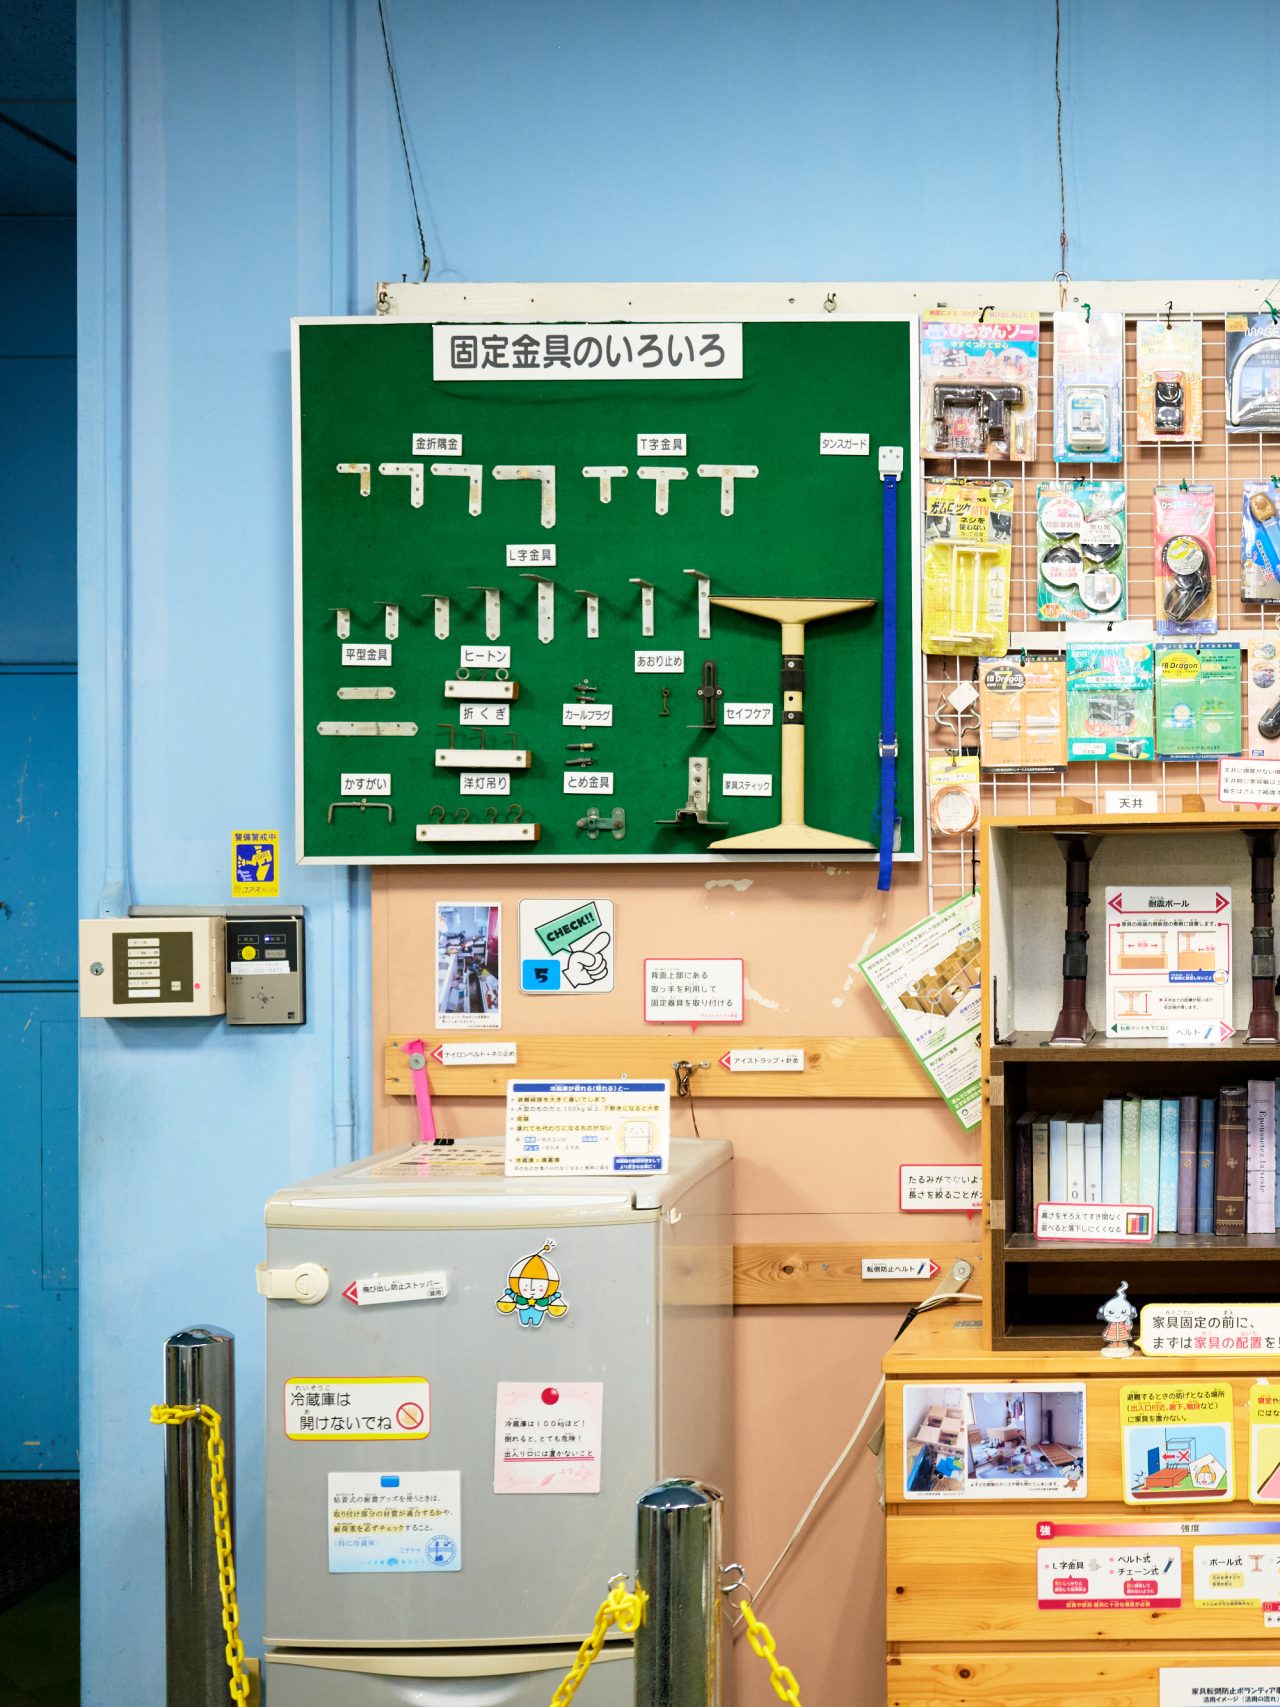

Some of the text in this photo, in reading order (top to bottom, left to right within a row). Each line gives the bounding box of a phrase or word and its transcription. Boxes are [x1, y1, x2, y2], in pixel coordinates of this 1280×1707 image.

[451, 334, 726, 369] 固定金具のいろいろ
[415, 437, 458, 452] 金折隅金
[641, 437, 683, 451] T字金具
[822, 437, 868, 451] タンスガード
[509, 549, 551, 562] L字金具
[346, 649, 388, 661] 平型金具
[466, 650, 507, 662] ヒートン
[637, 655, 683, 667] あおり止め
[565, 710, 611, 721] カールプラグ
[726, 708, 771, 719] セイフケア
[345, 778, 387, 791] かすがい
[464, 778, 508, 790] 洋灯吊り
[568, 776, 610, 788] とめ金具
[725, 781, 770, 792] 家具スティック
[1119, 798, 1143, 808] 天井
[546, 911, 597, 944] CHECK!!
[535, 969, 549, 983] 5
[651, 971, 708, 979] 背面上部にある
[651, 985, 716, 993] 取っ手を利用して
[651, 999, 734, 1007] 固定器具を取り付ける
[362, 1280, 440, 1294] 飛び出し防止ストッパー
[1152, 1315, 1253, 1329] 家具固定の前に、
[290, 1392, 352, 1407] 冷蔵庫は
[300, 1416, 392, 1431] 開けないでね
[1127, 1414, 1187, 1423] に家具を置かない。
[1040, 1525, 1051, 1536] 強
[1180, 1524, 1201, 1534] 強度
[1052, 1562, 1084, 1570] L字金具
[1118, 1557, 1151, 1565] ベルト式
[1118, 1568, 1159, 1576] チェーン式
